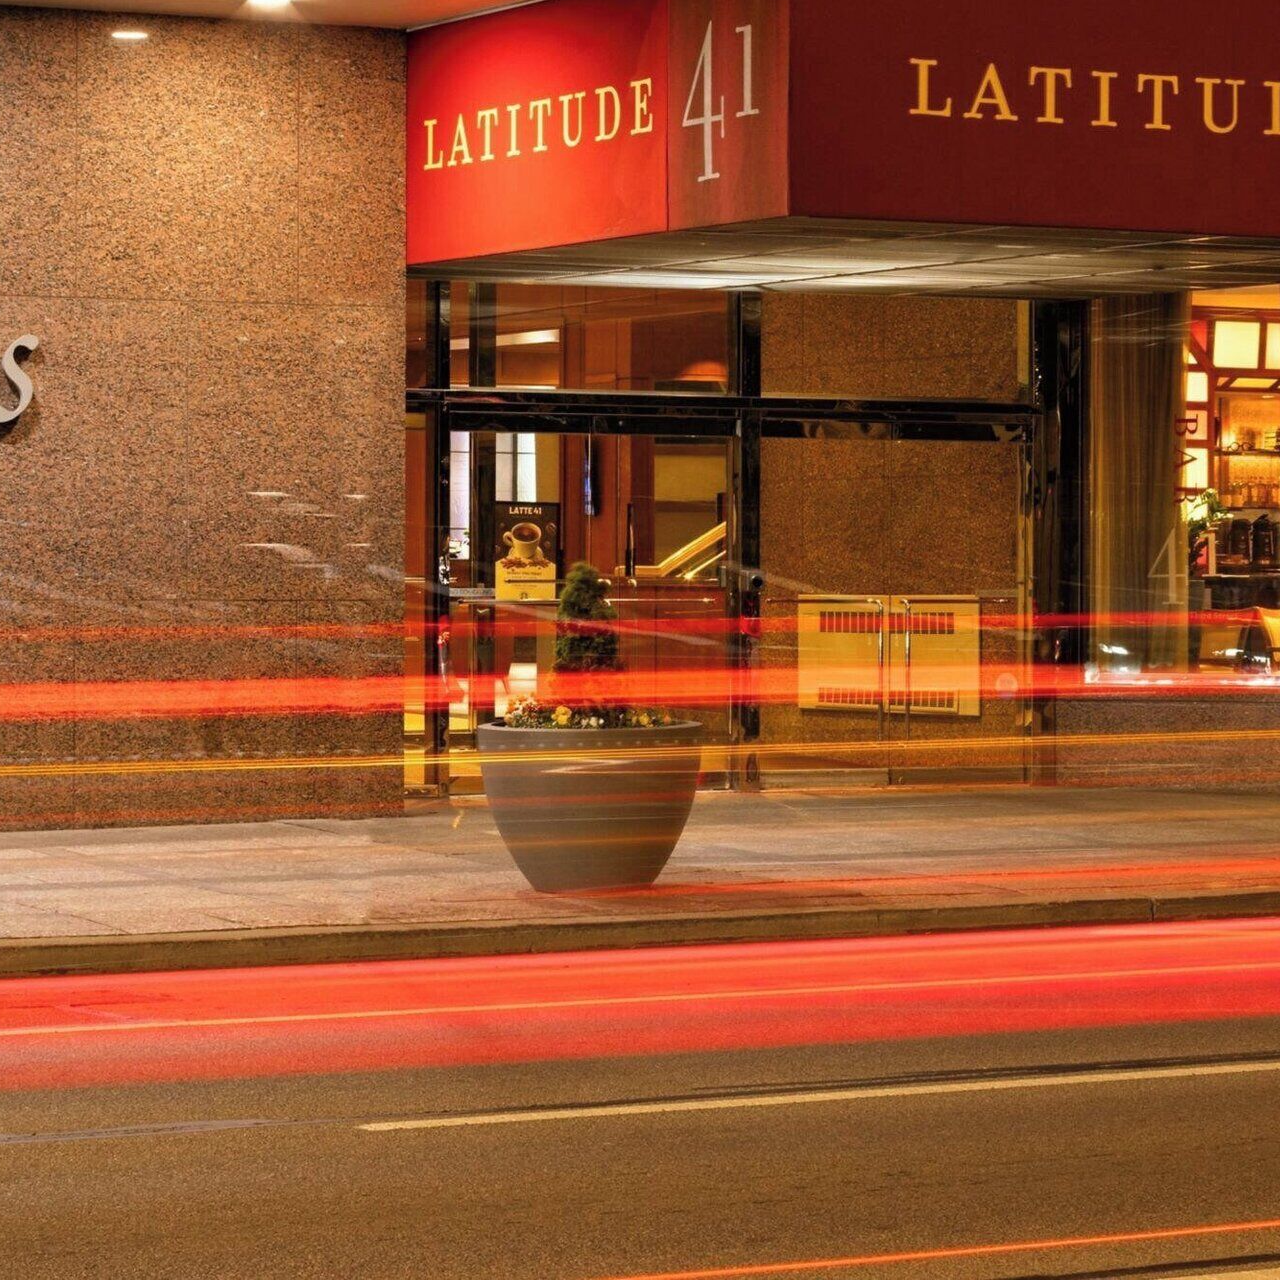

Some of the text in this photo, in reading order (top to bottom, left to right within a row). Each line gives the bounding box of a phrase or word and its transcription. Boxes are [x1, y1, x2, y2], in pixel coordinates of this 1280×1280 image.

[423, 20, 760, 183] LATITUDE 41
[1174, 414, 1199, 505] BAR
[509, 506, 533, 515] LATTE
